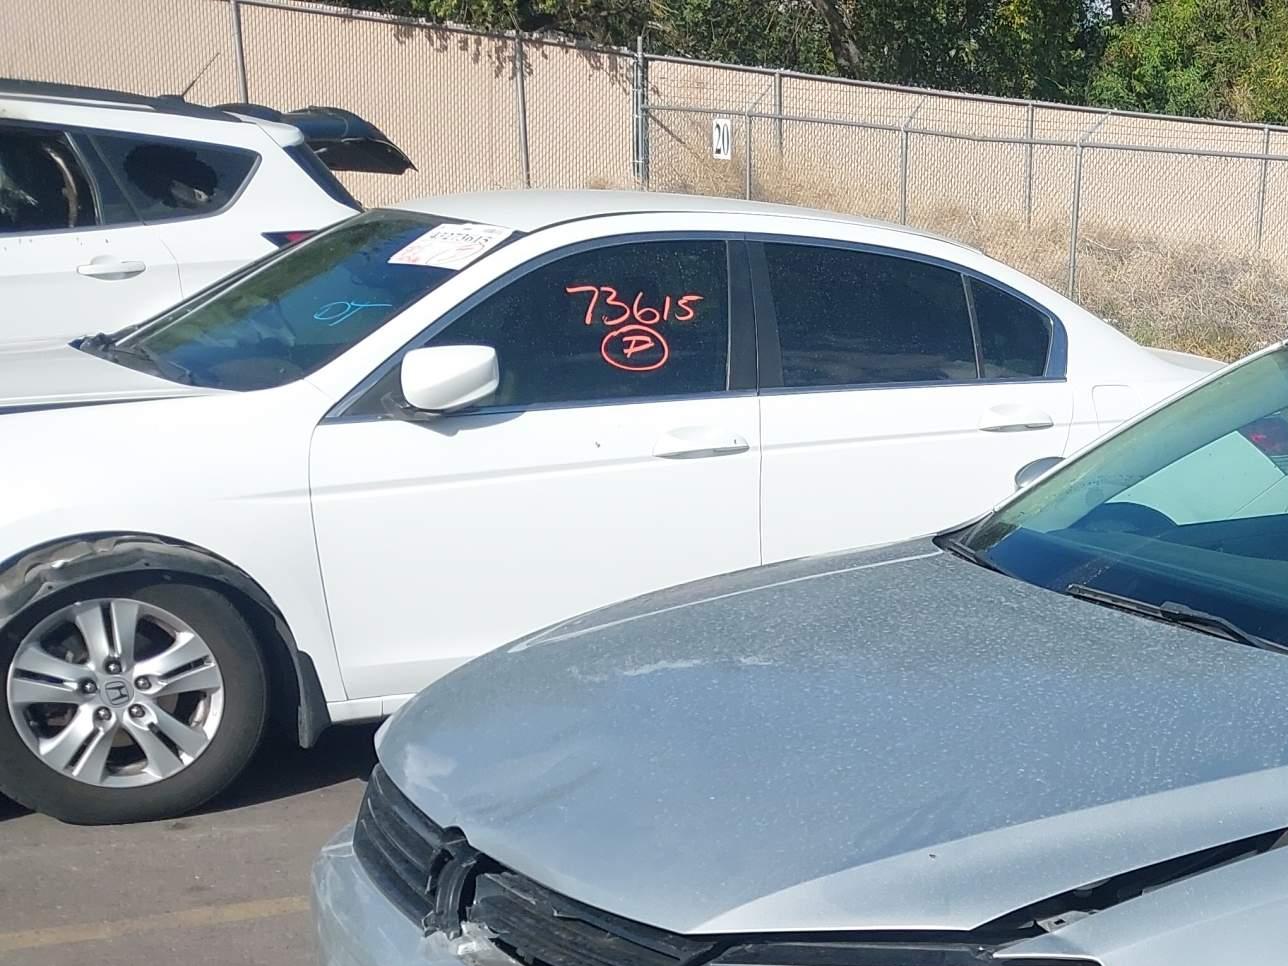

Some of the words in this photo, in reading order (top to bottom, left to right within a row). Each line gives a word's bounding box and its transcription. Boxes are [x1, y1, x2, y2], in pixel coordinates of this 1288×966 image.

[715, 123, 729, 155] 20
[313, 301, 393, 327] DT
[565, 286, 704, 325] 73615
